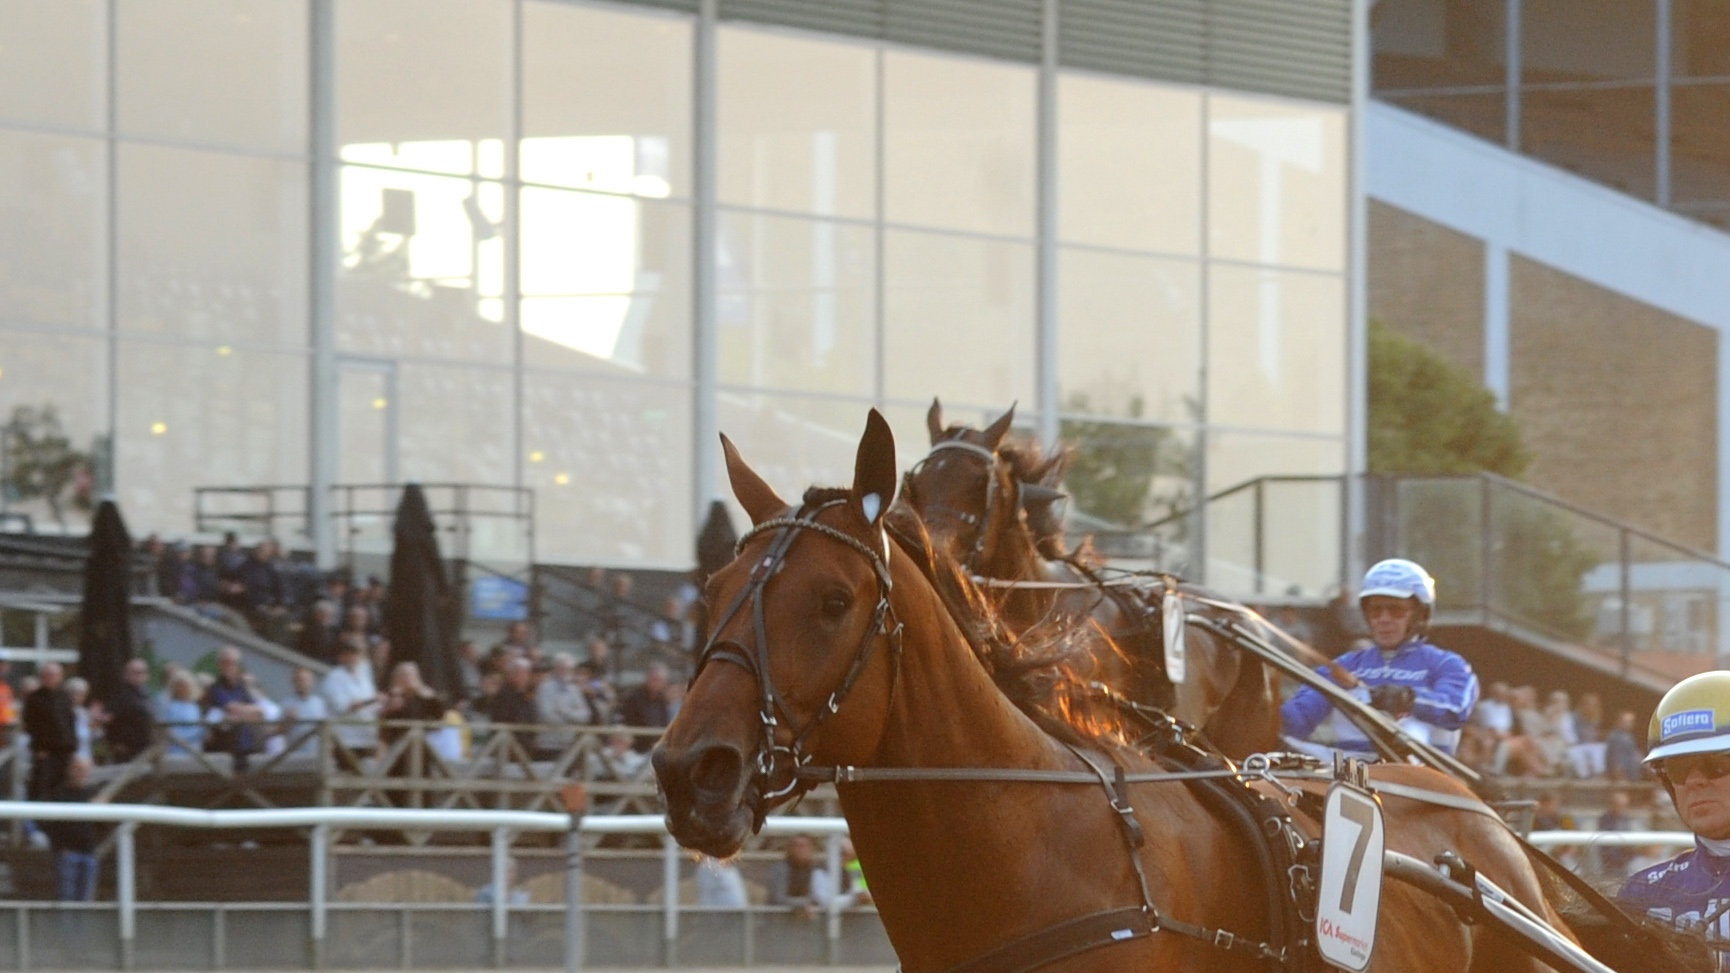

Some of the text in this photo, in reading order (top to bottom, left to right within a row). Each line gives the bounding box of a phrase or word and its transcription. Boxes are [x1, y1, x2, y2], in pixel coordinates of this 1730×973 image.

[1663, 713, 1709, 735] Sofiero
[1339, 793, 1374, 915] 7
[1319, 917, 1333, 938] ICA
